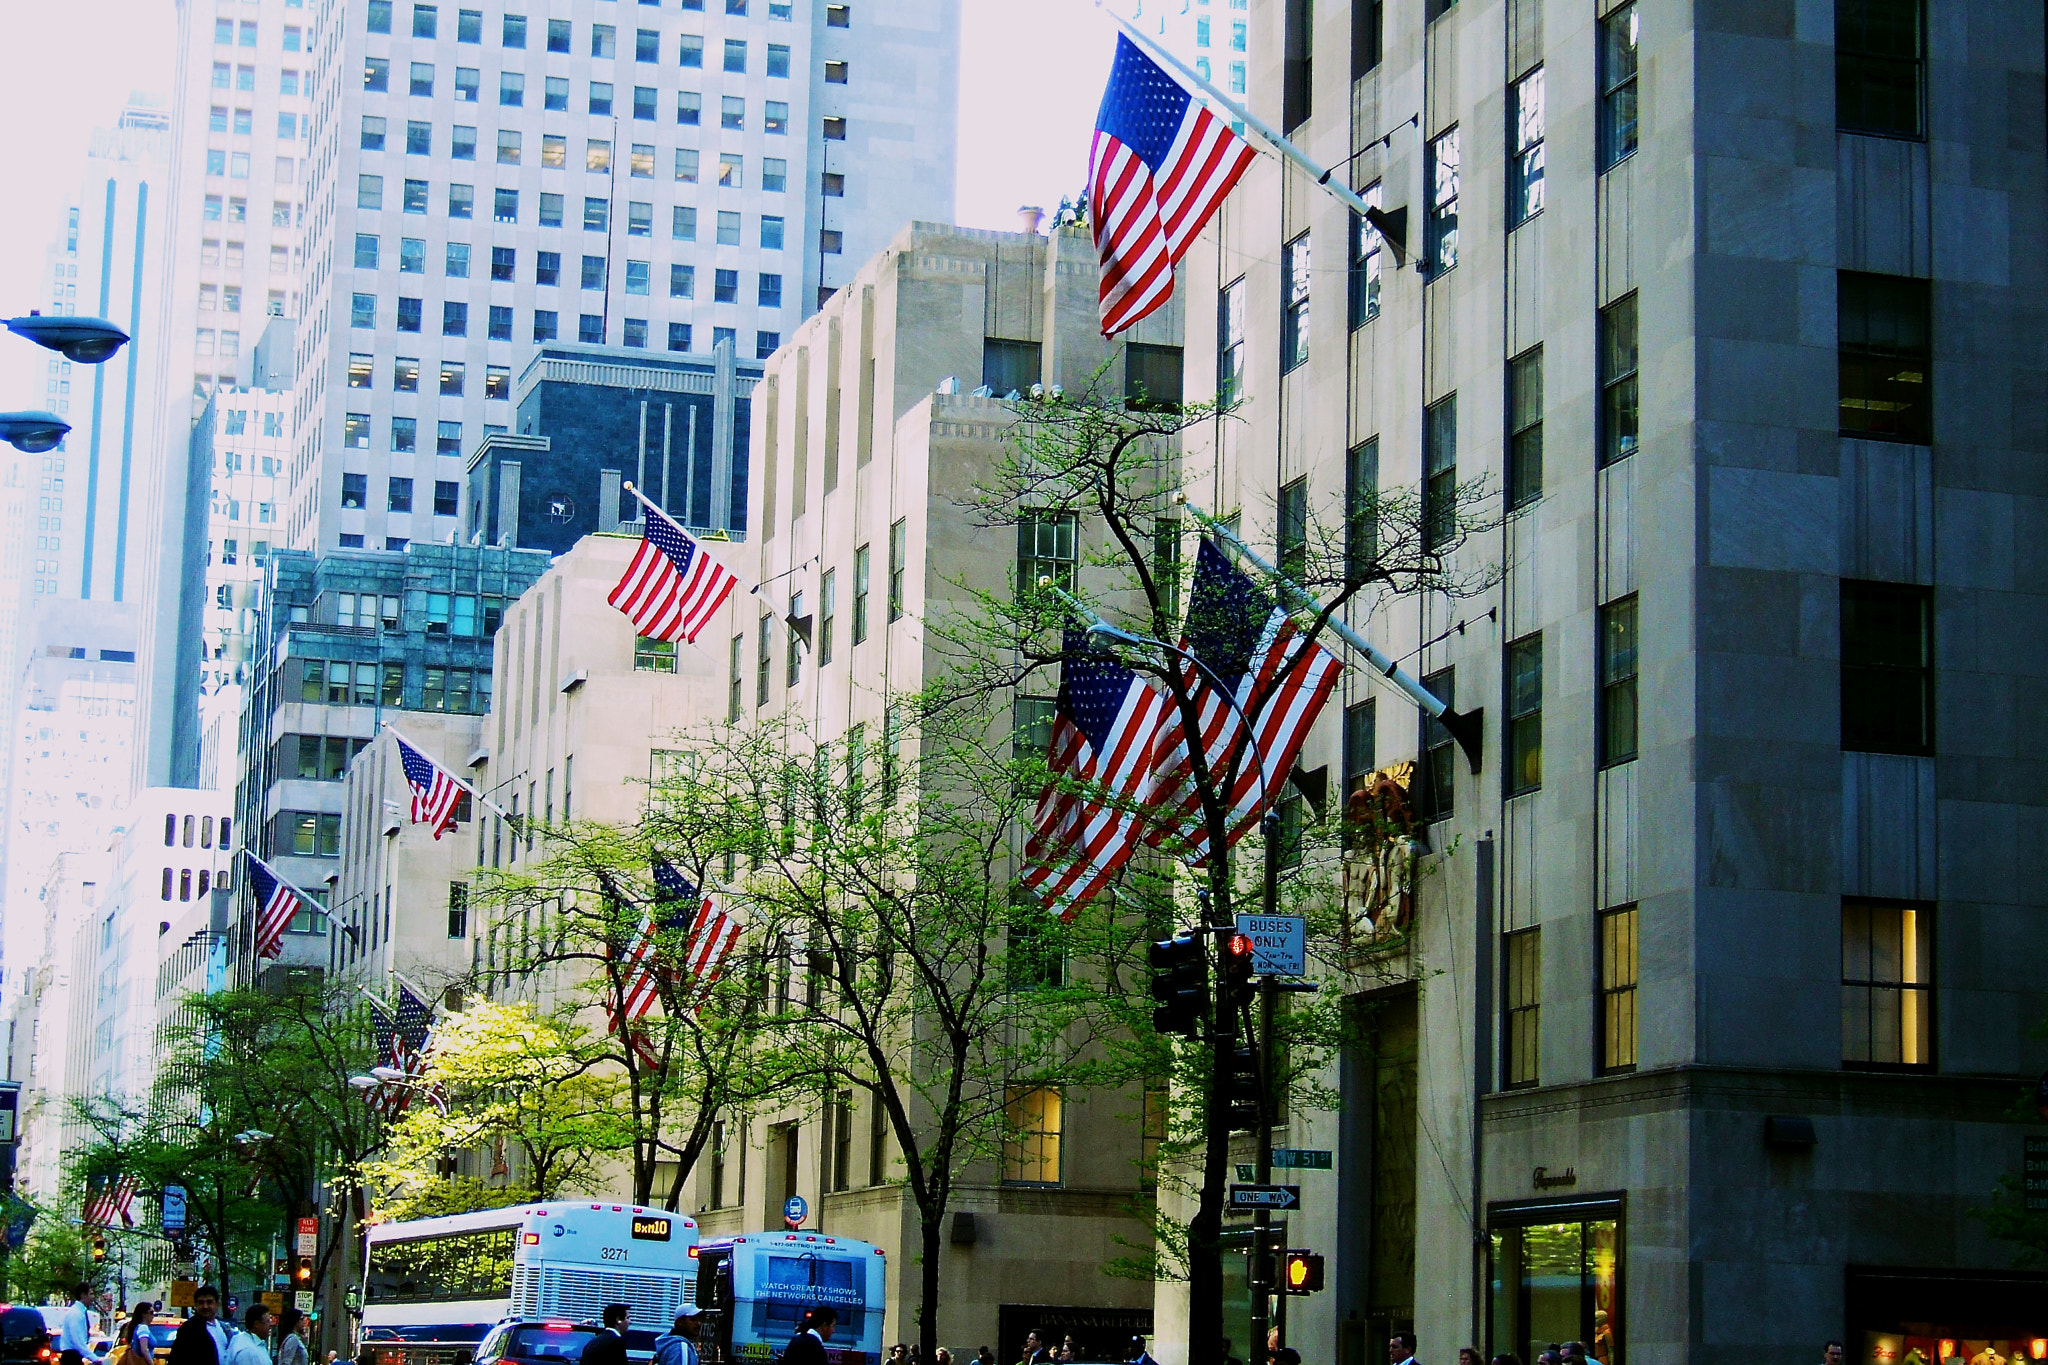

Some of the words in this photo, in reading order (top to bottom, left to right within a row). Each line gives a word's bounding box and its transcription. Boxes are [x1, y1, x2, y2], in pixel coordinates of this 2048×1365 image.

[1250, 920, 1292, 933] BUSES
[1254, 936, 1287, 948] ONLY
[1288, 962, 1300, 970] FRI
[1286, 1152, 1296, 1166] W
[1303, 1152, 1316, 1166] 51
[1240, 1192, 1260, 1202] ONE
[1269, 1192, 1290, 1202] WAY
[634, 1220, 668, 1235] BxM10
[601, 1247, 628, 1261] 3271
[760, 1282, 789, 1290] WATCH
[790, 1284, 816, 1292] GREAT
[828, 1287, 857, 1296] SHOWS
[772, 1291, 816, 1300] NETWORKS
[817, 1295, 863, 1305] CANCELLED
[1040, 1313, 1098, 1327] BANANA
[1101, 1315, 1153, 1328] REPUBL
[735, 1345, 785, 1355] BRILLIAN
